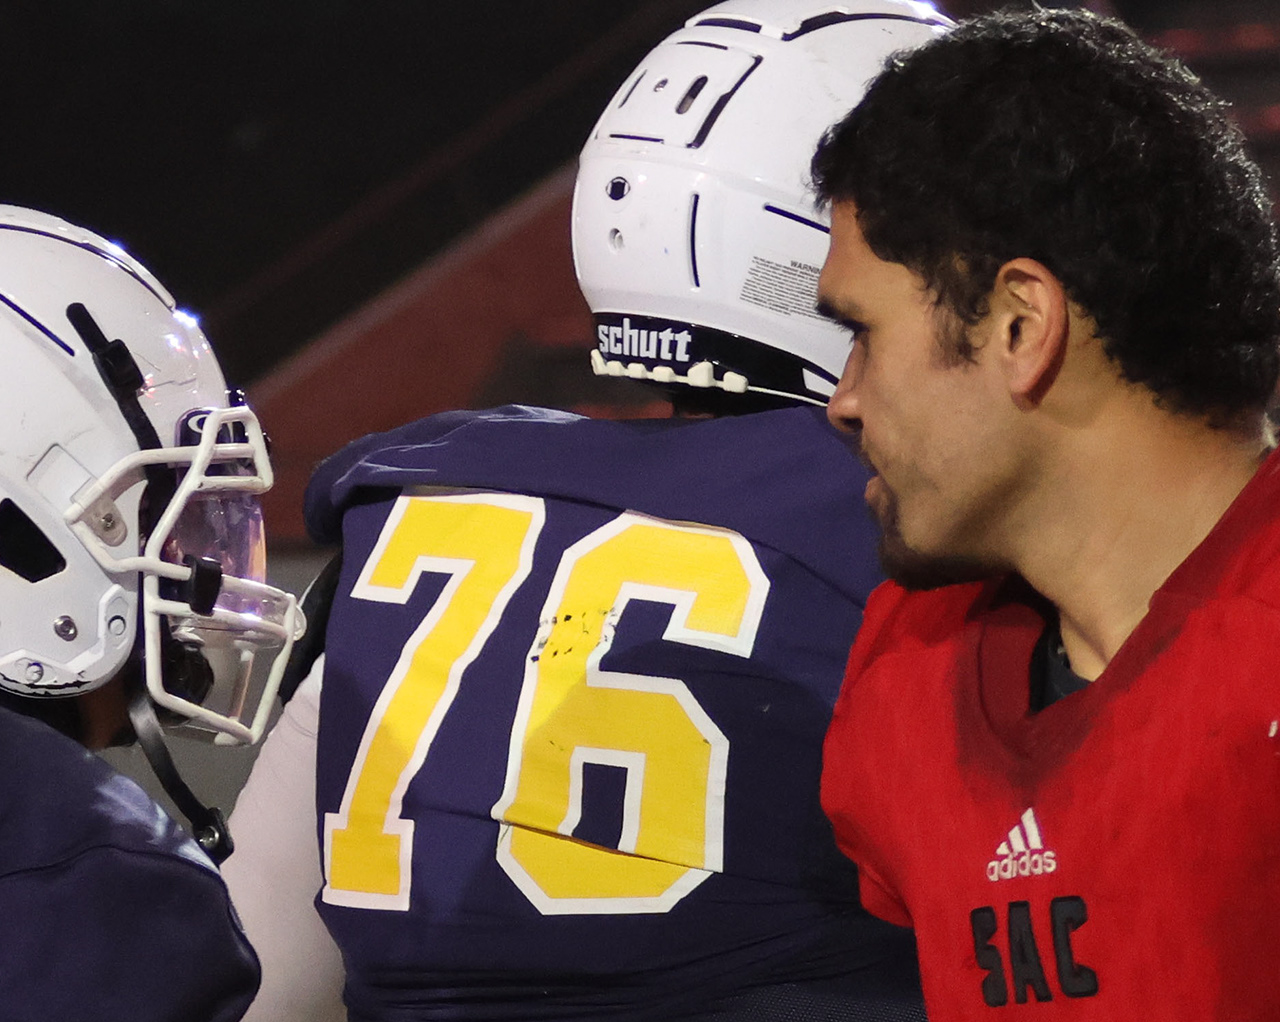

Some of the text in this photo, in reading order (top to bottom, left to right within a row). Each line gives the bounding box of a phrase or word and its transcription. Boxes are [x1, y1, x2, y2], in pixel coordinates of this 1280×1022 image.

[598, 318, 692, 362] schutt
[322, 494, 770, 914] 76
[987, 850, 1057, 882] adidas
[971, 896, 1099, 1007] SAC
